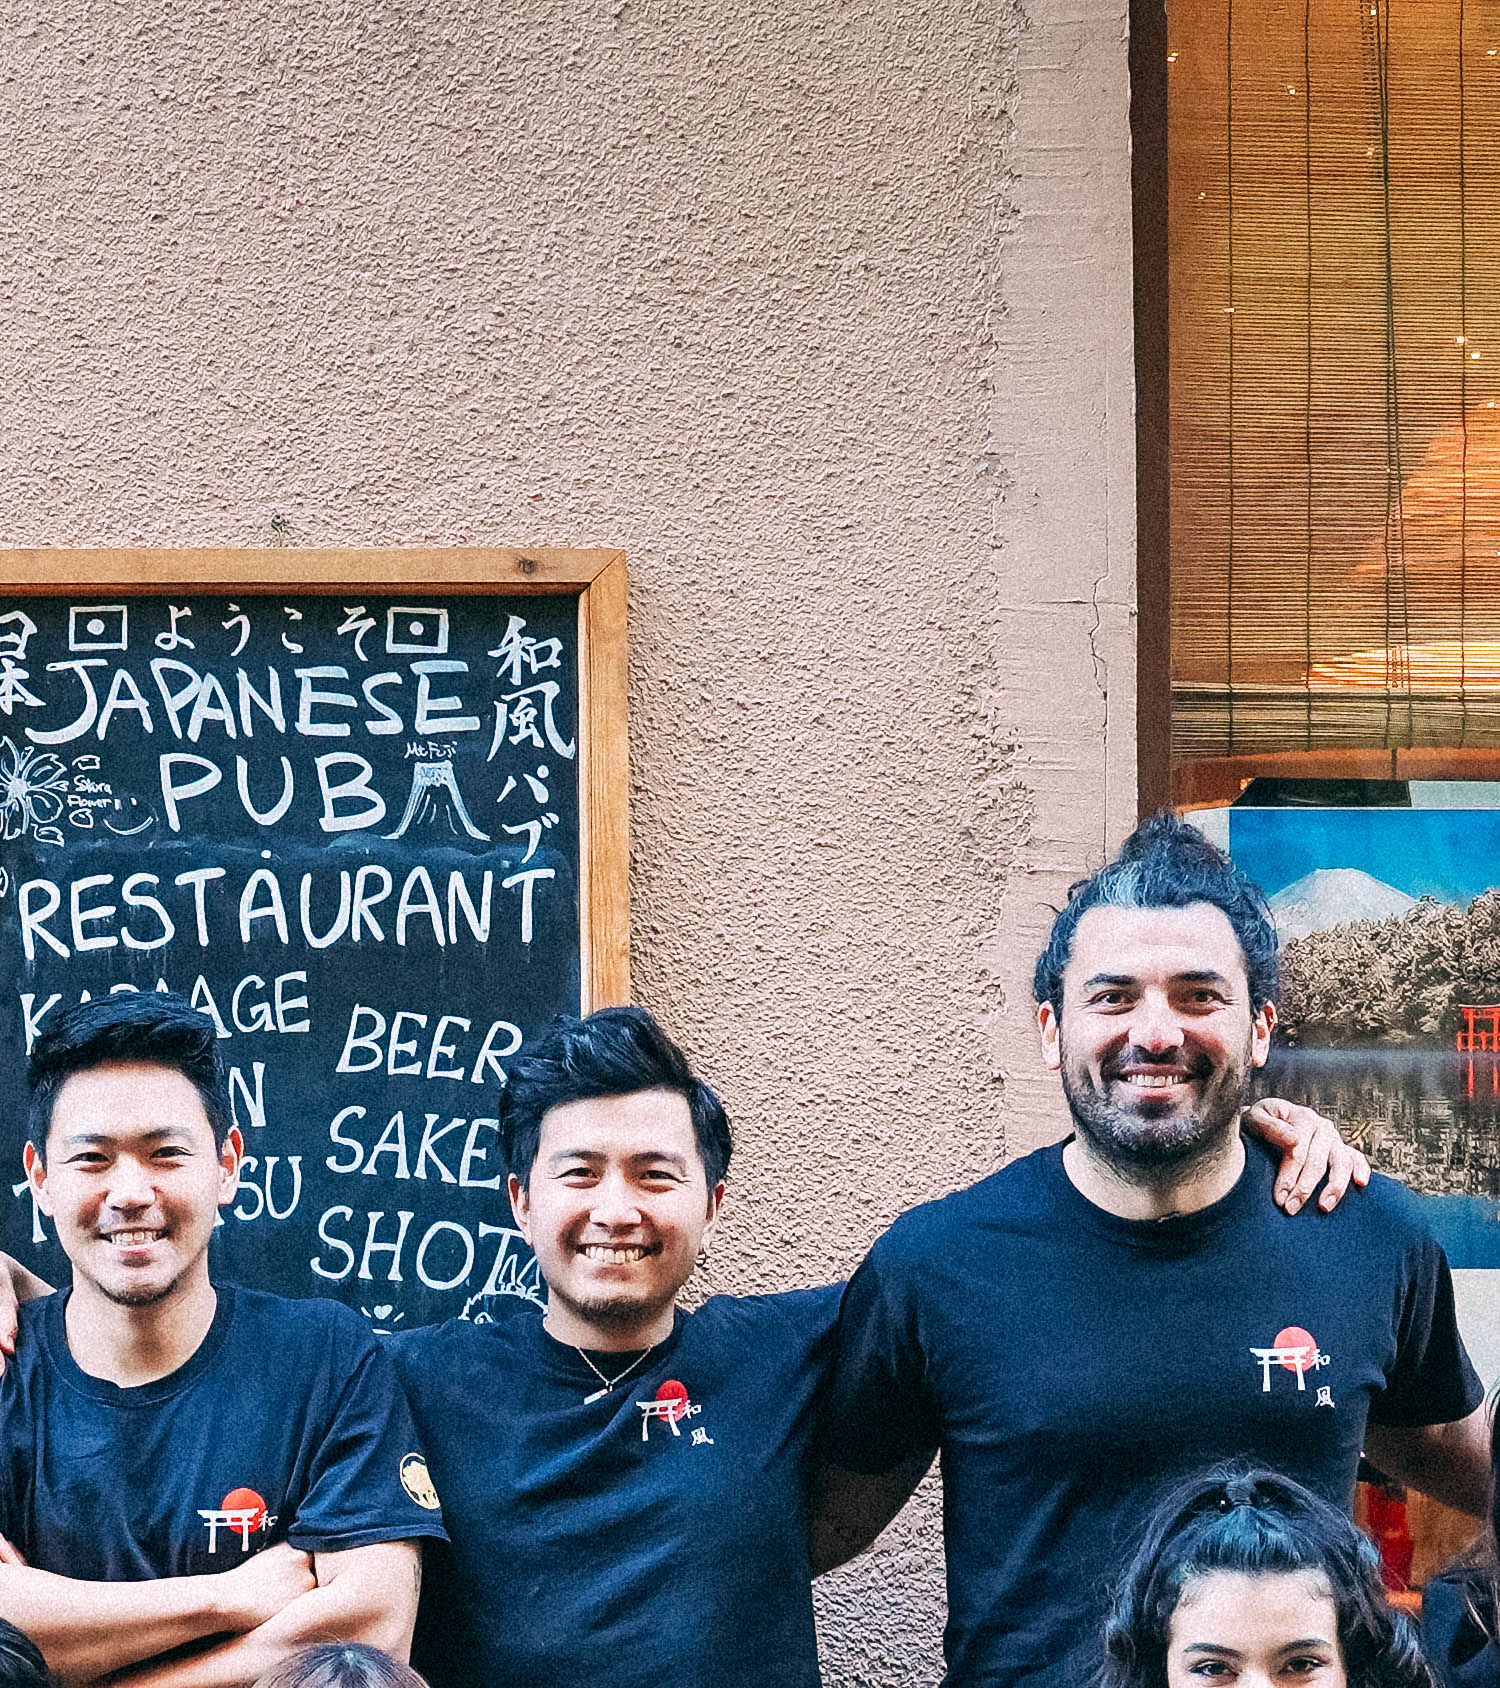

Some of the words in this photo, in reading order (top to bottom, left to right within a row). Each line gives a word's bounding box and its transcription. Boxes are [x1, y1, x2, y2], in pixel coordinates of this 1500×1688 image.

[154, 603, 377, 662] ようこそ
[24, 658, 481, 745] JAPANESE
[486, 614, 576, 864] 和風パブ
[159, 752, 387, 833] PUB
[18, 865, 556, 960] RESTAURANT
[19, 970, 311, 1056] KAGE
[336, 1003, 523, 1088] BEER
[325, 1105, 501, 1190] SAKE
